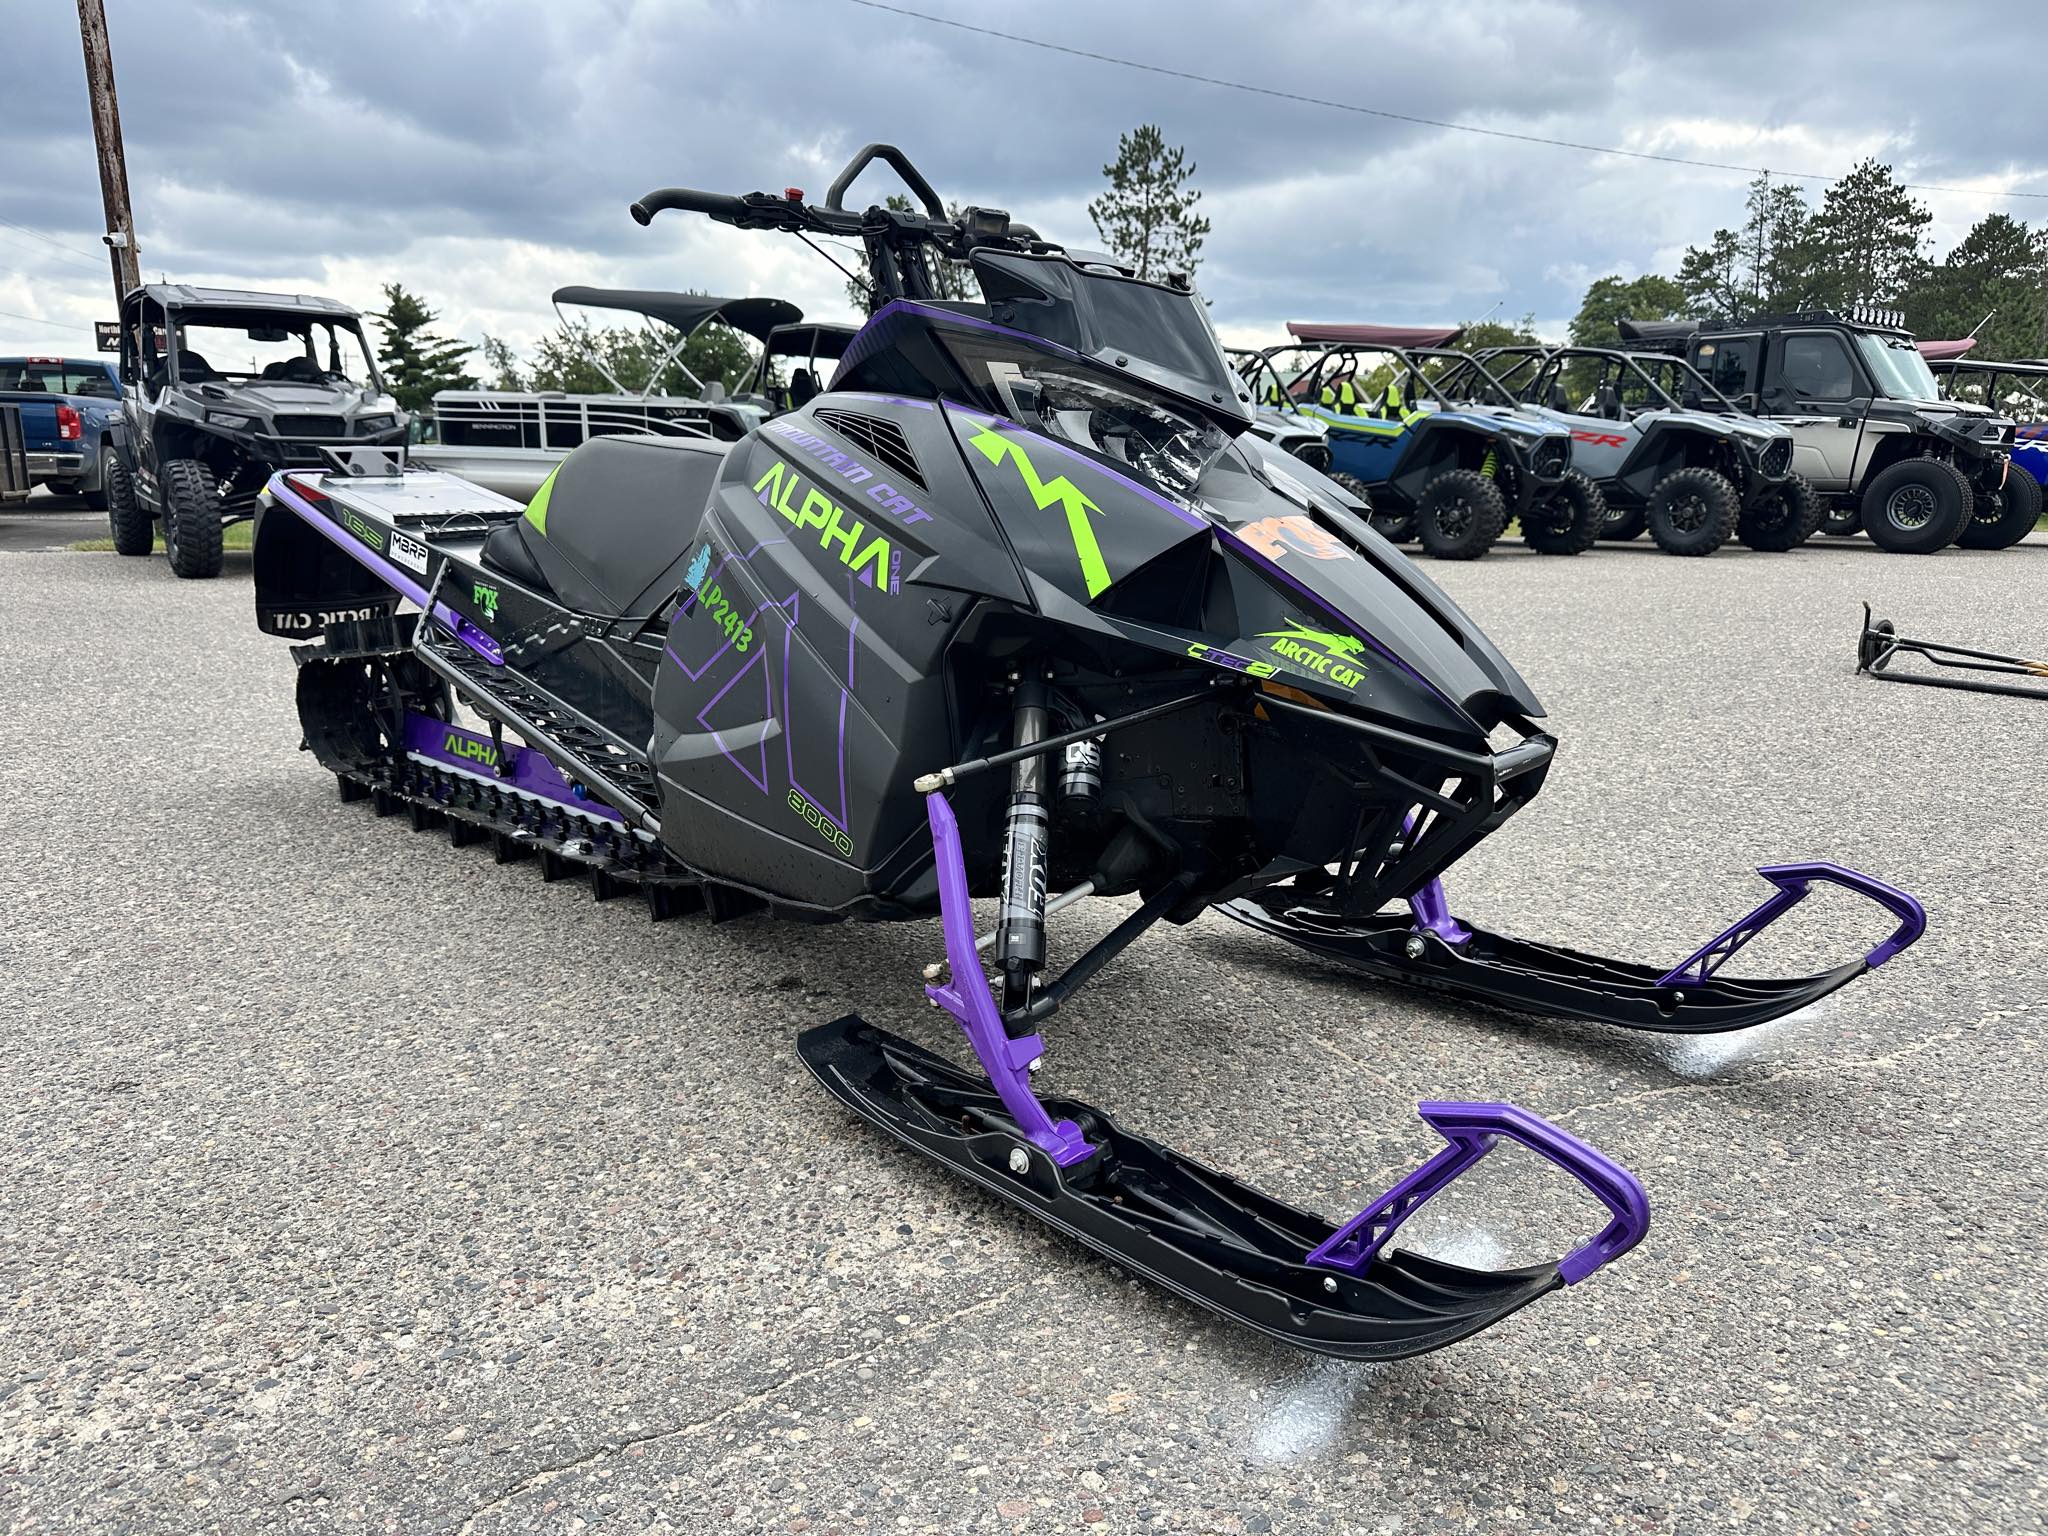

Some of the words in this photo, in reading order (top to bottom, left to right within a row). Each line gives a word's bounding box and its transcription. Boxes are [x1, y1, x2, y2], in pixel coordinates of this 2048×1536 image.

[766, 421, 873, 484] MOUNTAIN
[866, 483, 934, 525] CAT
[342, 508, 384, 550] 165
[392, 533, 427, 560] MBRP
[753, 461, 891, 593] ALPHA
[1234, 515, 1342, 561] FOX
[473, 585, 499, 614] FOX
[889, 550, 902, 597] ONE
[697, 575, 753, 653] LP2413
[1269, 637, 1334, 674] ARCTIC
[1328, 664, 1366, 689] CAT
[787, 788, 854, 858] 8000
[1027, 835, 1048, 922] FOX
